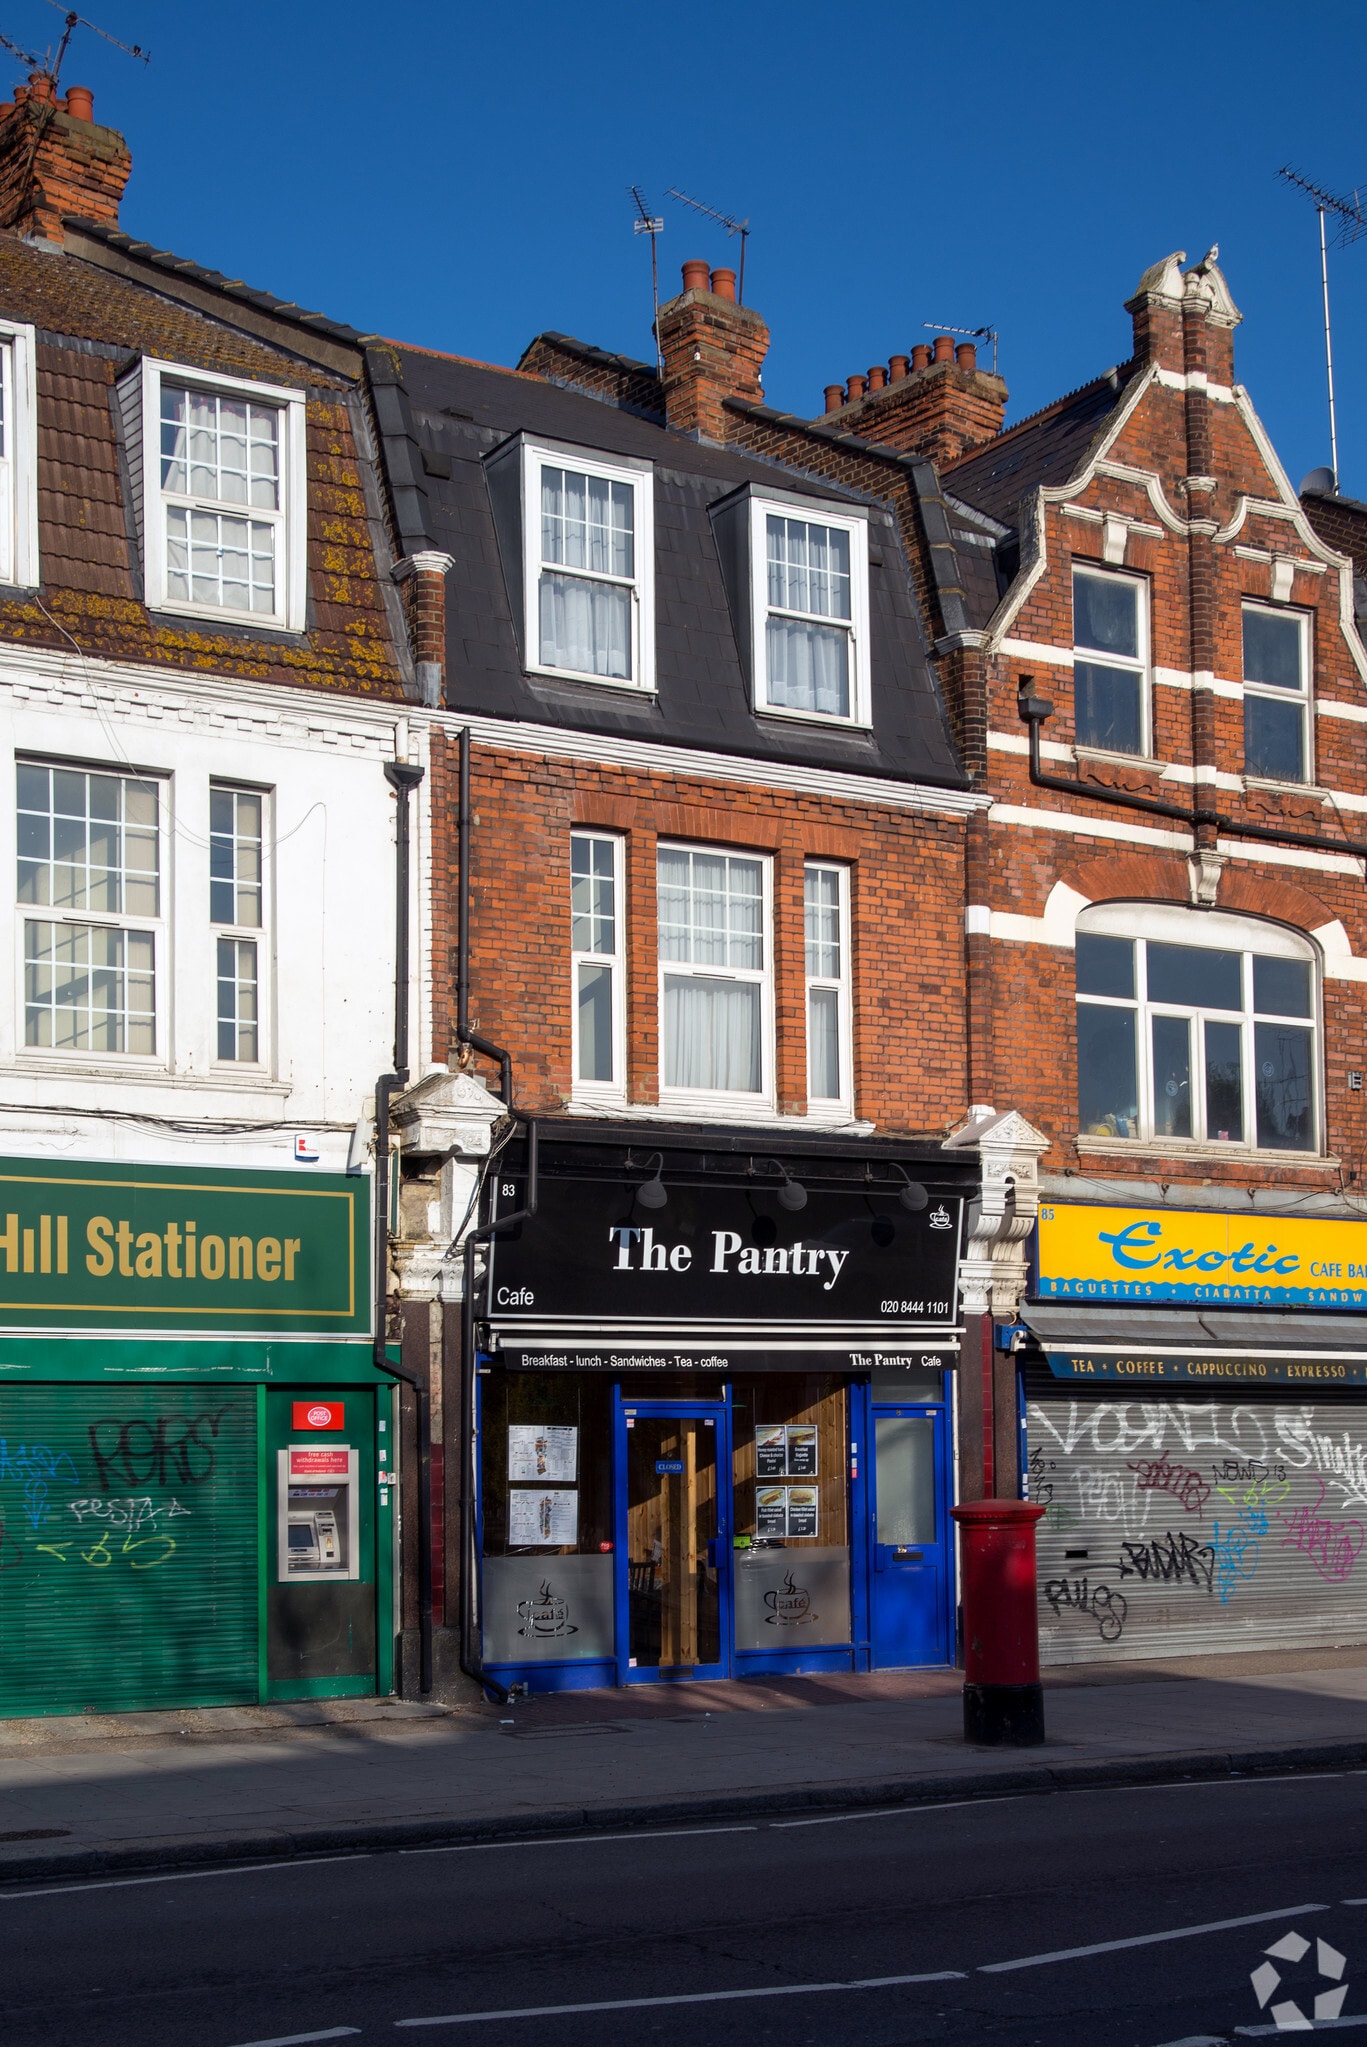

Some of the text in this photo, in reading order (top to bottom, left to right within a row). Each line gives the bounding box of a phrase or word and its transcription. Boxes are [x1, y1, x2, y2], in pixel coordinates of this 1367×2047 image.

[502, 1184, 515, 1196] 83
[1041, 1208, 1055, 1220] 85
[86, 1216, 300, 1281] Stationer
[1098, 1221, 1301, 1275] Exotic
[609, 1227, 849, 1290] The Pantry
[1310, 1262, 1342, 1277] CAFE
[497, 1287, 534, 1306] Cafe
[1050, 1282, 1362, 1302] BAGUETTES CIABATTA SANDW
[880, 1301, 949, 1314] 020 8444 1101
[521, 1354, 568, 1367] Breakfast
[576, 1355, 601, 1367] lunch
[610, 1355, 666, 1367] Sandwiches
[674, 1356, 692, 1368] Tea
[700, 1356, 728, 1368] coffee
[849, 1353, 941, 1370] The Pantry Cafe
[1071, 1359, 1346, 1378] TEA COFFEE CAPPUCCINO EXPRESSO
[658, 1463, 682, 1471] CLOSED
